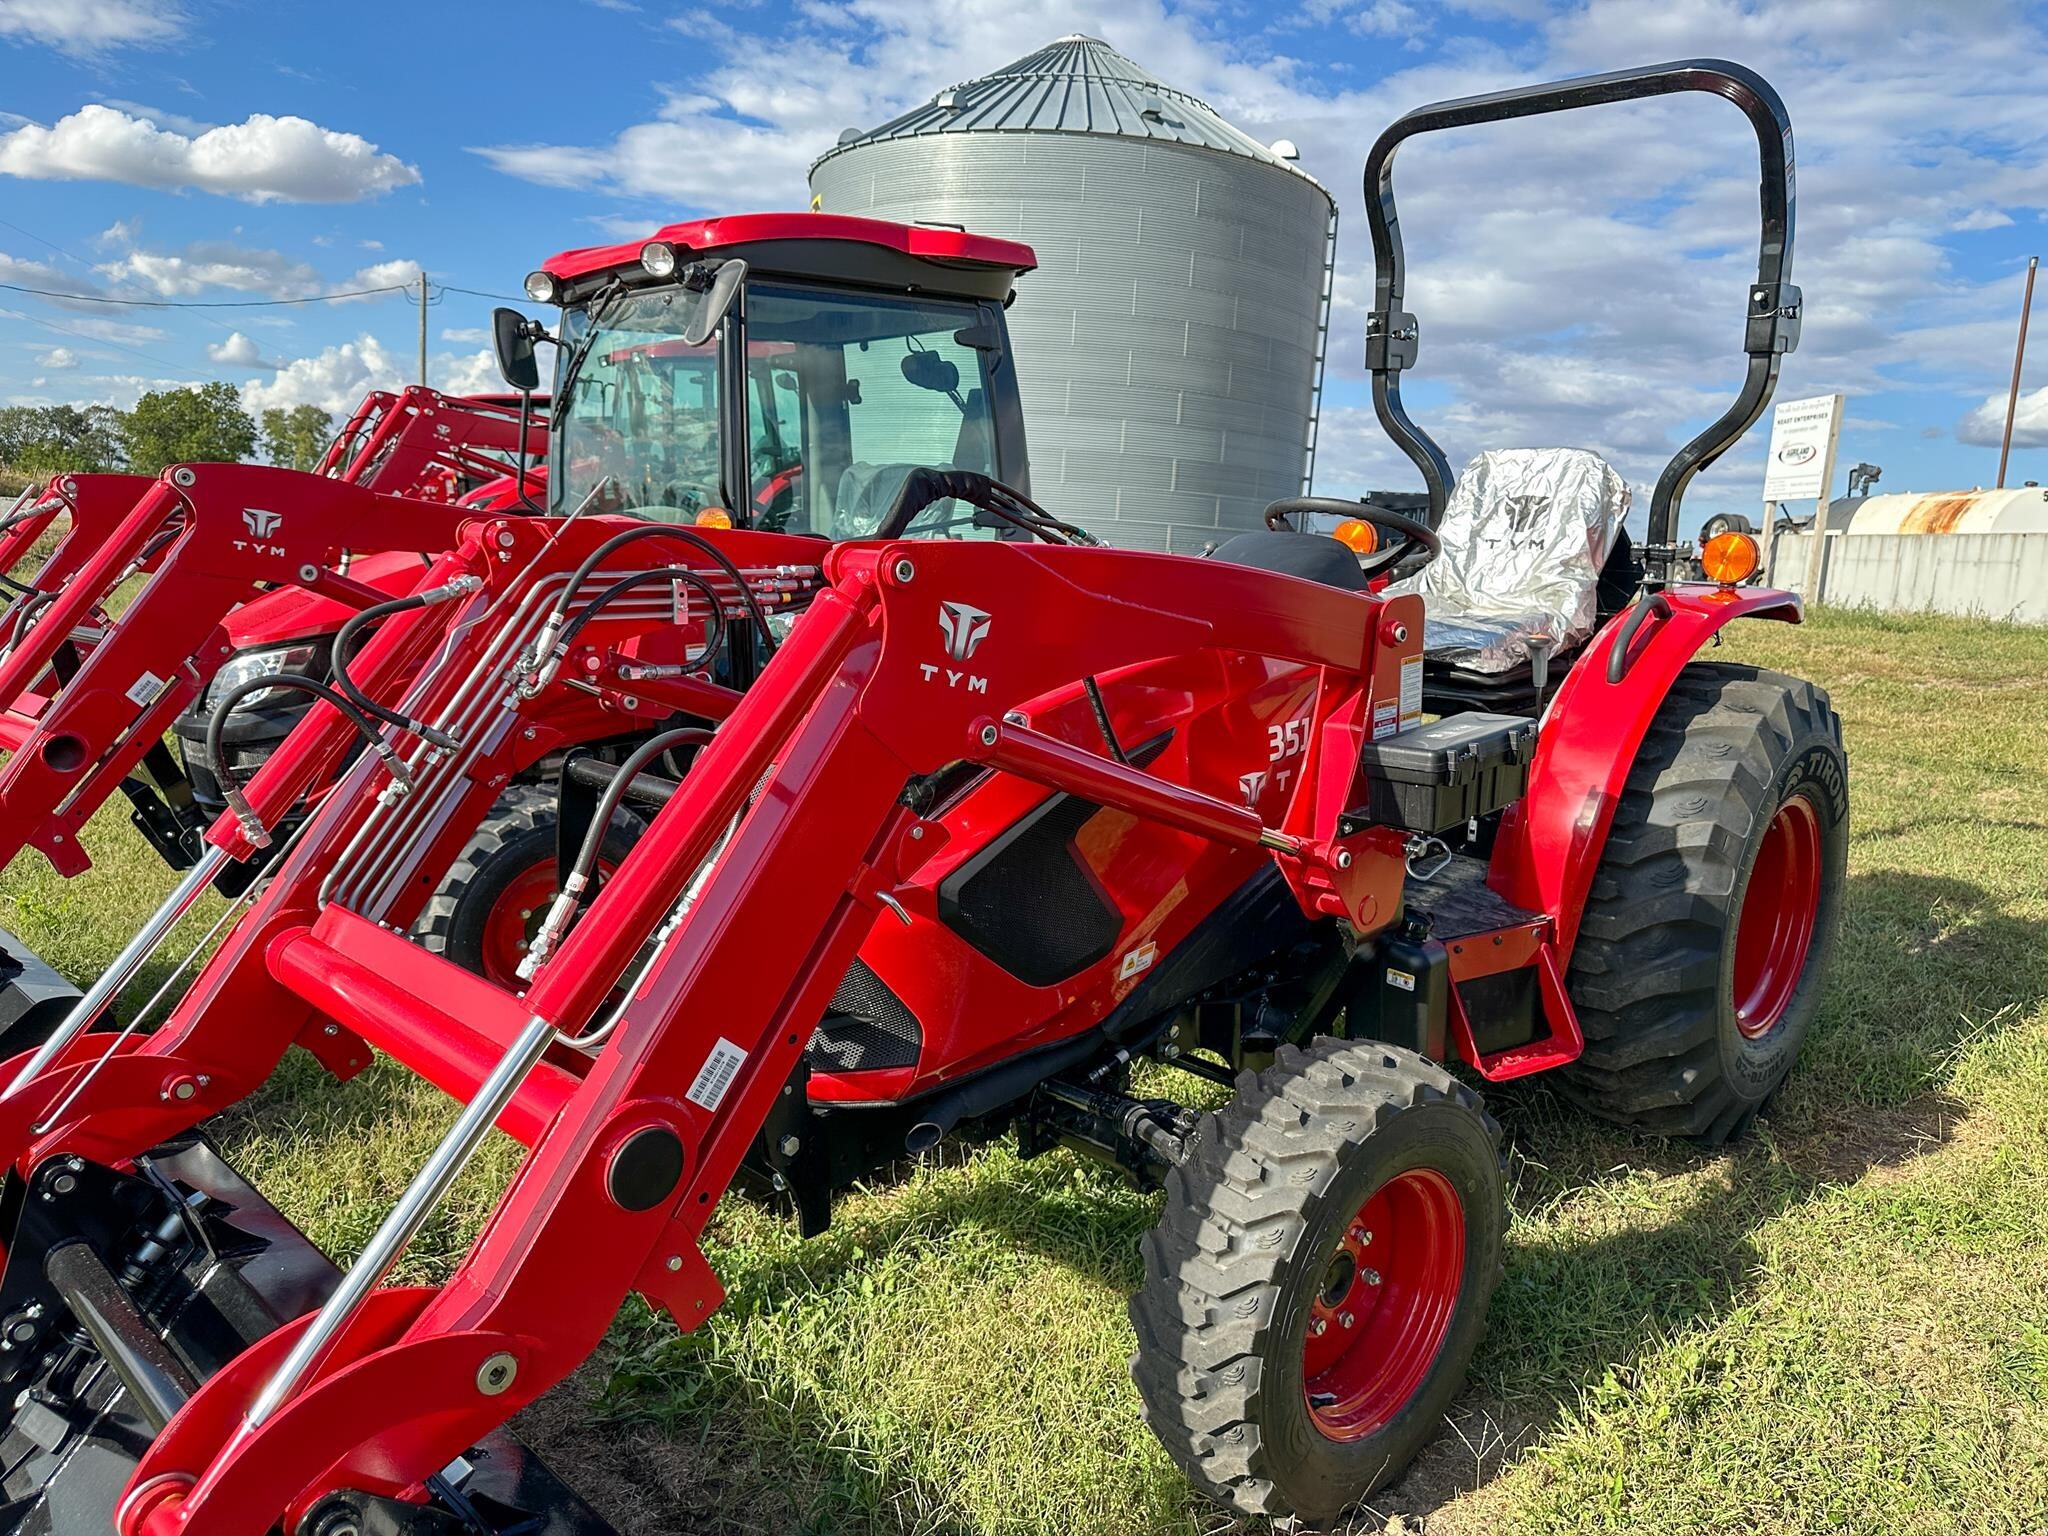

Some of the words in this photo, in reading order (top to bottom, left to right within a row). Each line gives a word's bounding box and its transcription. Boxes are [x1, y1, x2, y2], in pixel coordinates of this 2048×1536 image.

[233, 540, 286, 557] TYM
[1485, 538, 1545, 551] TYM
[920, 663, 988, 694] TYM
[1268, 717, 1310, 762] 351
